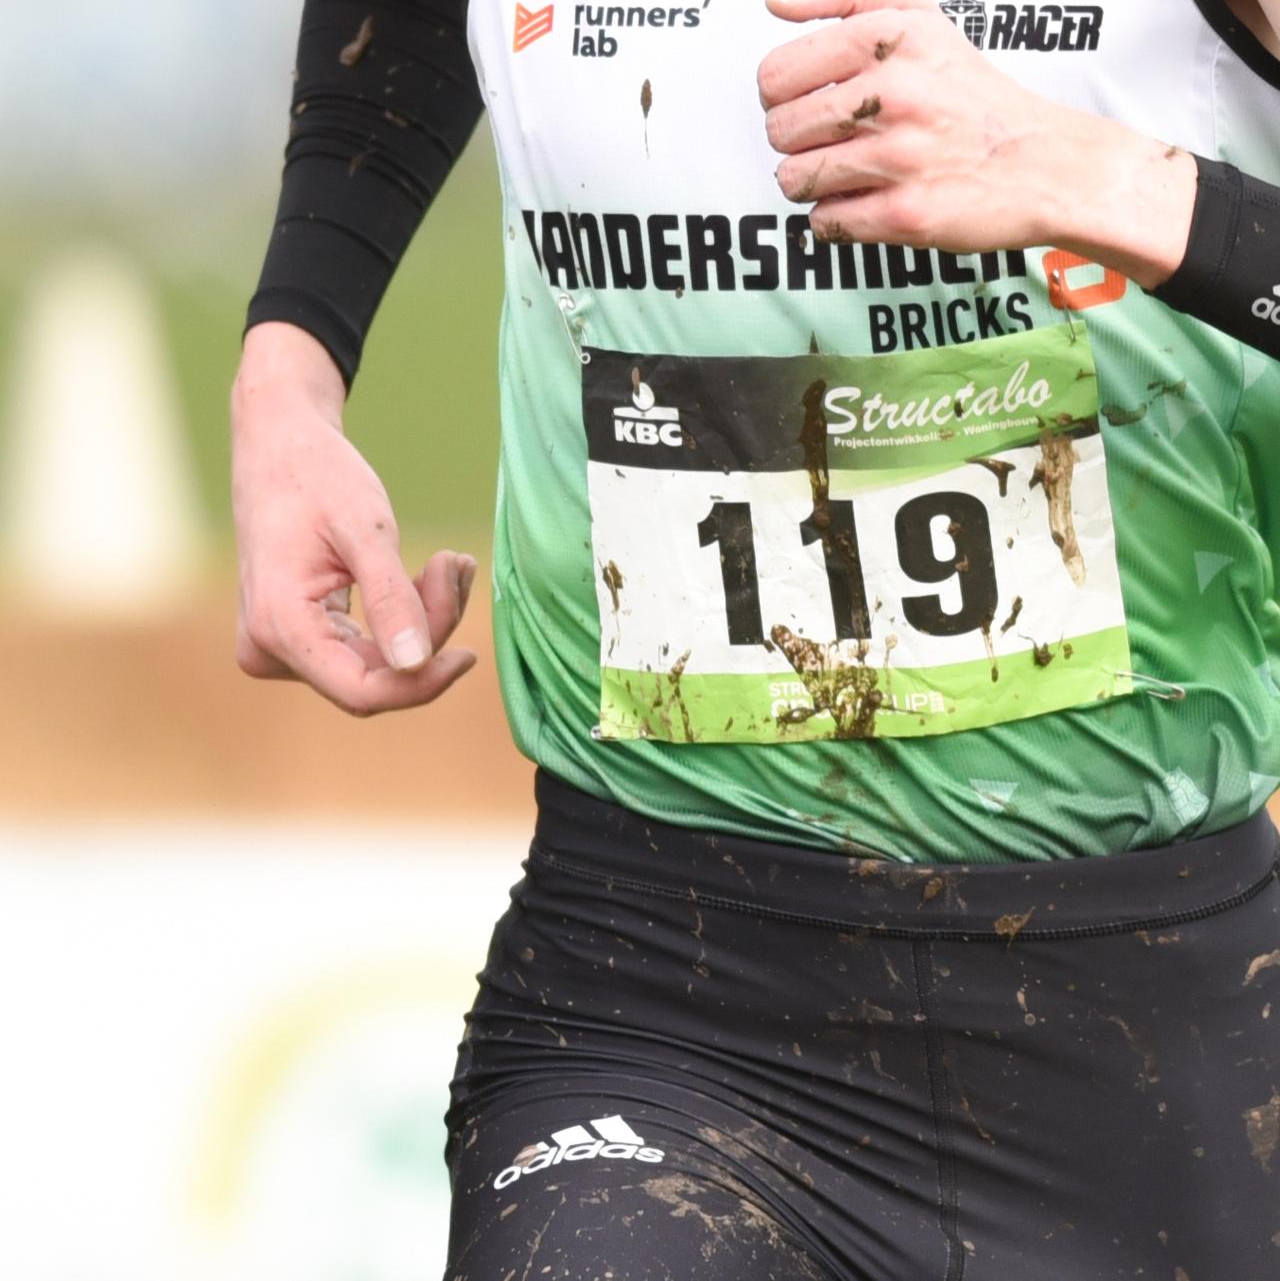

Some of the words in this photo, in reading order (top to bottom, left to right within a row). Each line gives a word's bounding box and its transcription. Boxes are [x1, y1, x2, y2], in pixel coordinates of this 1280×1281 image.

[571, 27, 619, 58] lab
[987, 3, 1105, 53] RACER
[867, 291, 1034, 354] BRICKS
[823, 360, 1053, 435] Structabo
[613, 419, 683, 448] KBC
[833, 430, 954, 449] Projectontwikkeli
[696, 491, 999, 646] 119
[493, 1139, 666, 1191] adidas
